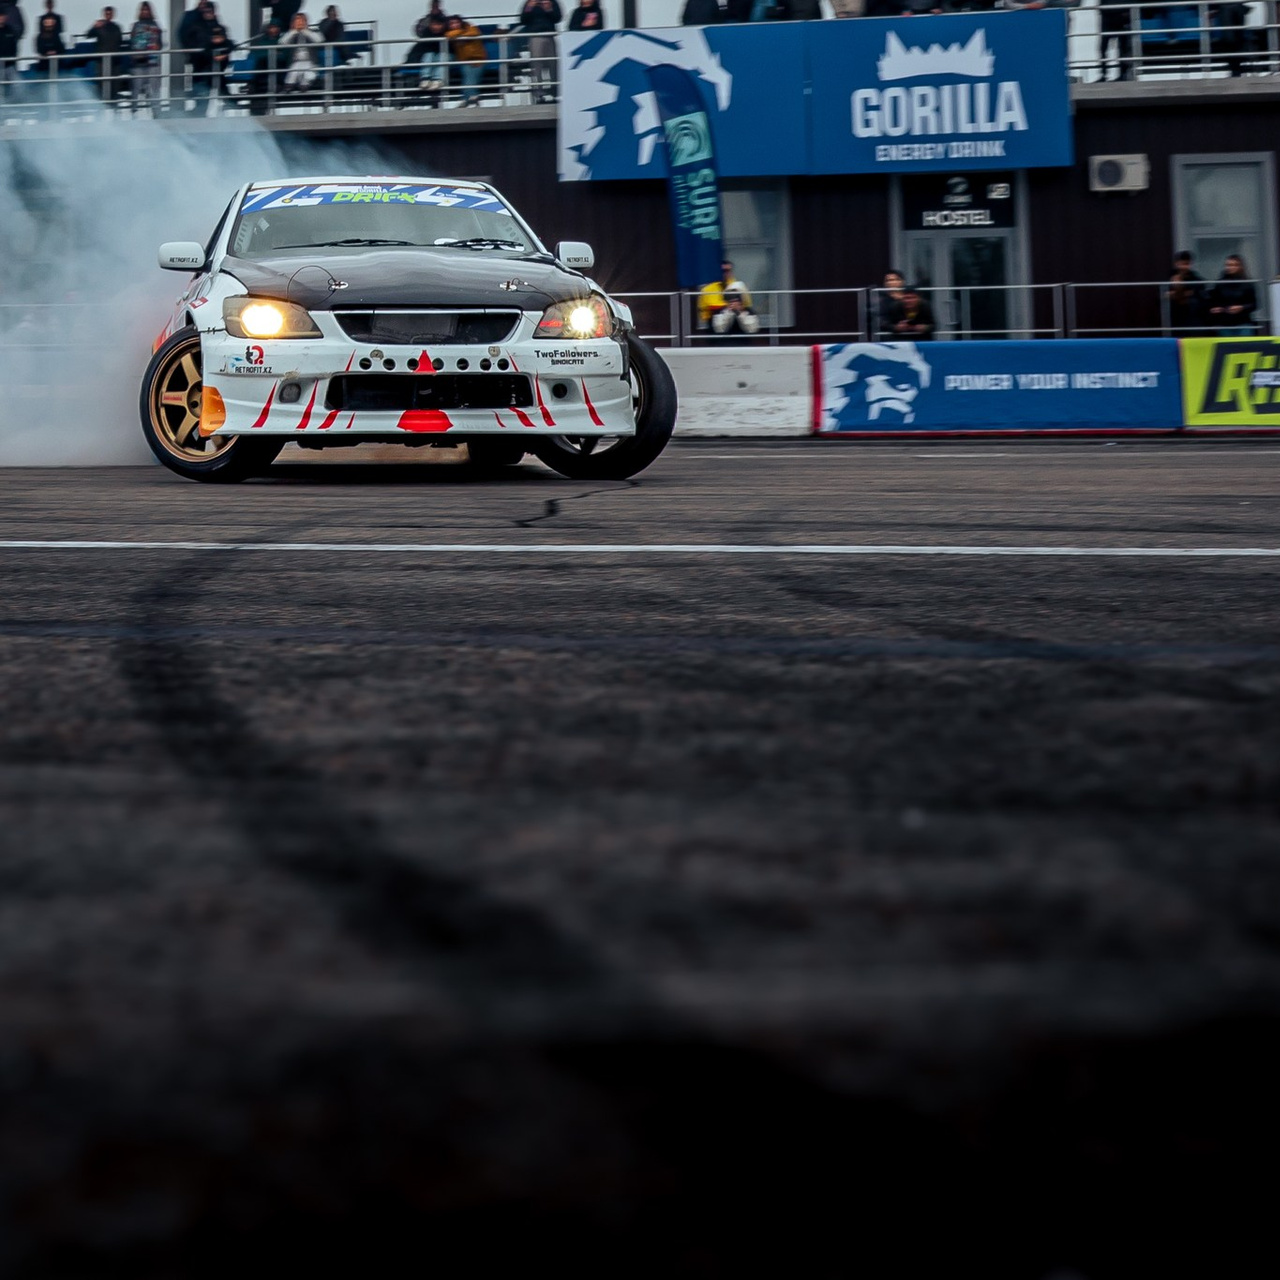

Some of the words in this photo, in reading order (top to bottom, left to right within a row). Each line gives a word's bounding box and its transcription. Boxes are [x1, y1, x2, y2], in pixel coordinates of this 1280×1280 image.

[851, 81, 1029, 138] GORILLA
[332, 192, 415, 203] DRIFT
[689, 168, 720, 240] SURF
[923, 210, 995, 226] HOSTEL
[535, 350, 599, 358] TwoFollowers
[944, 374, 1013, 391] POWER
[1015, 373, 1069, 390] YOUR
[1071, 372, 1160, 389] INSTINCT
